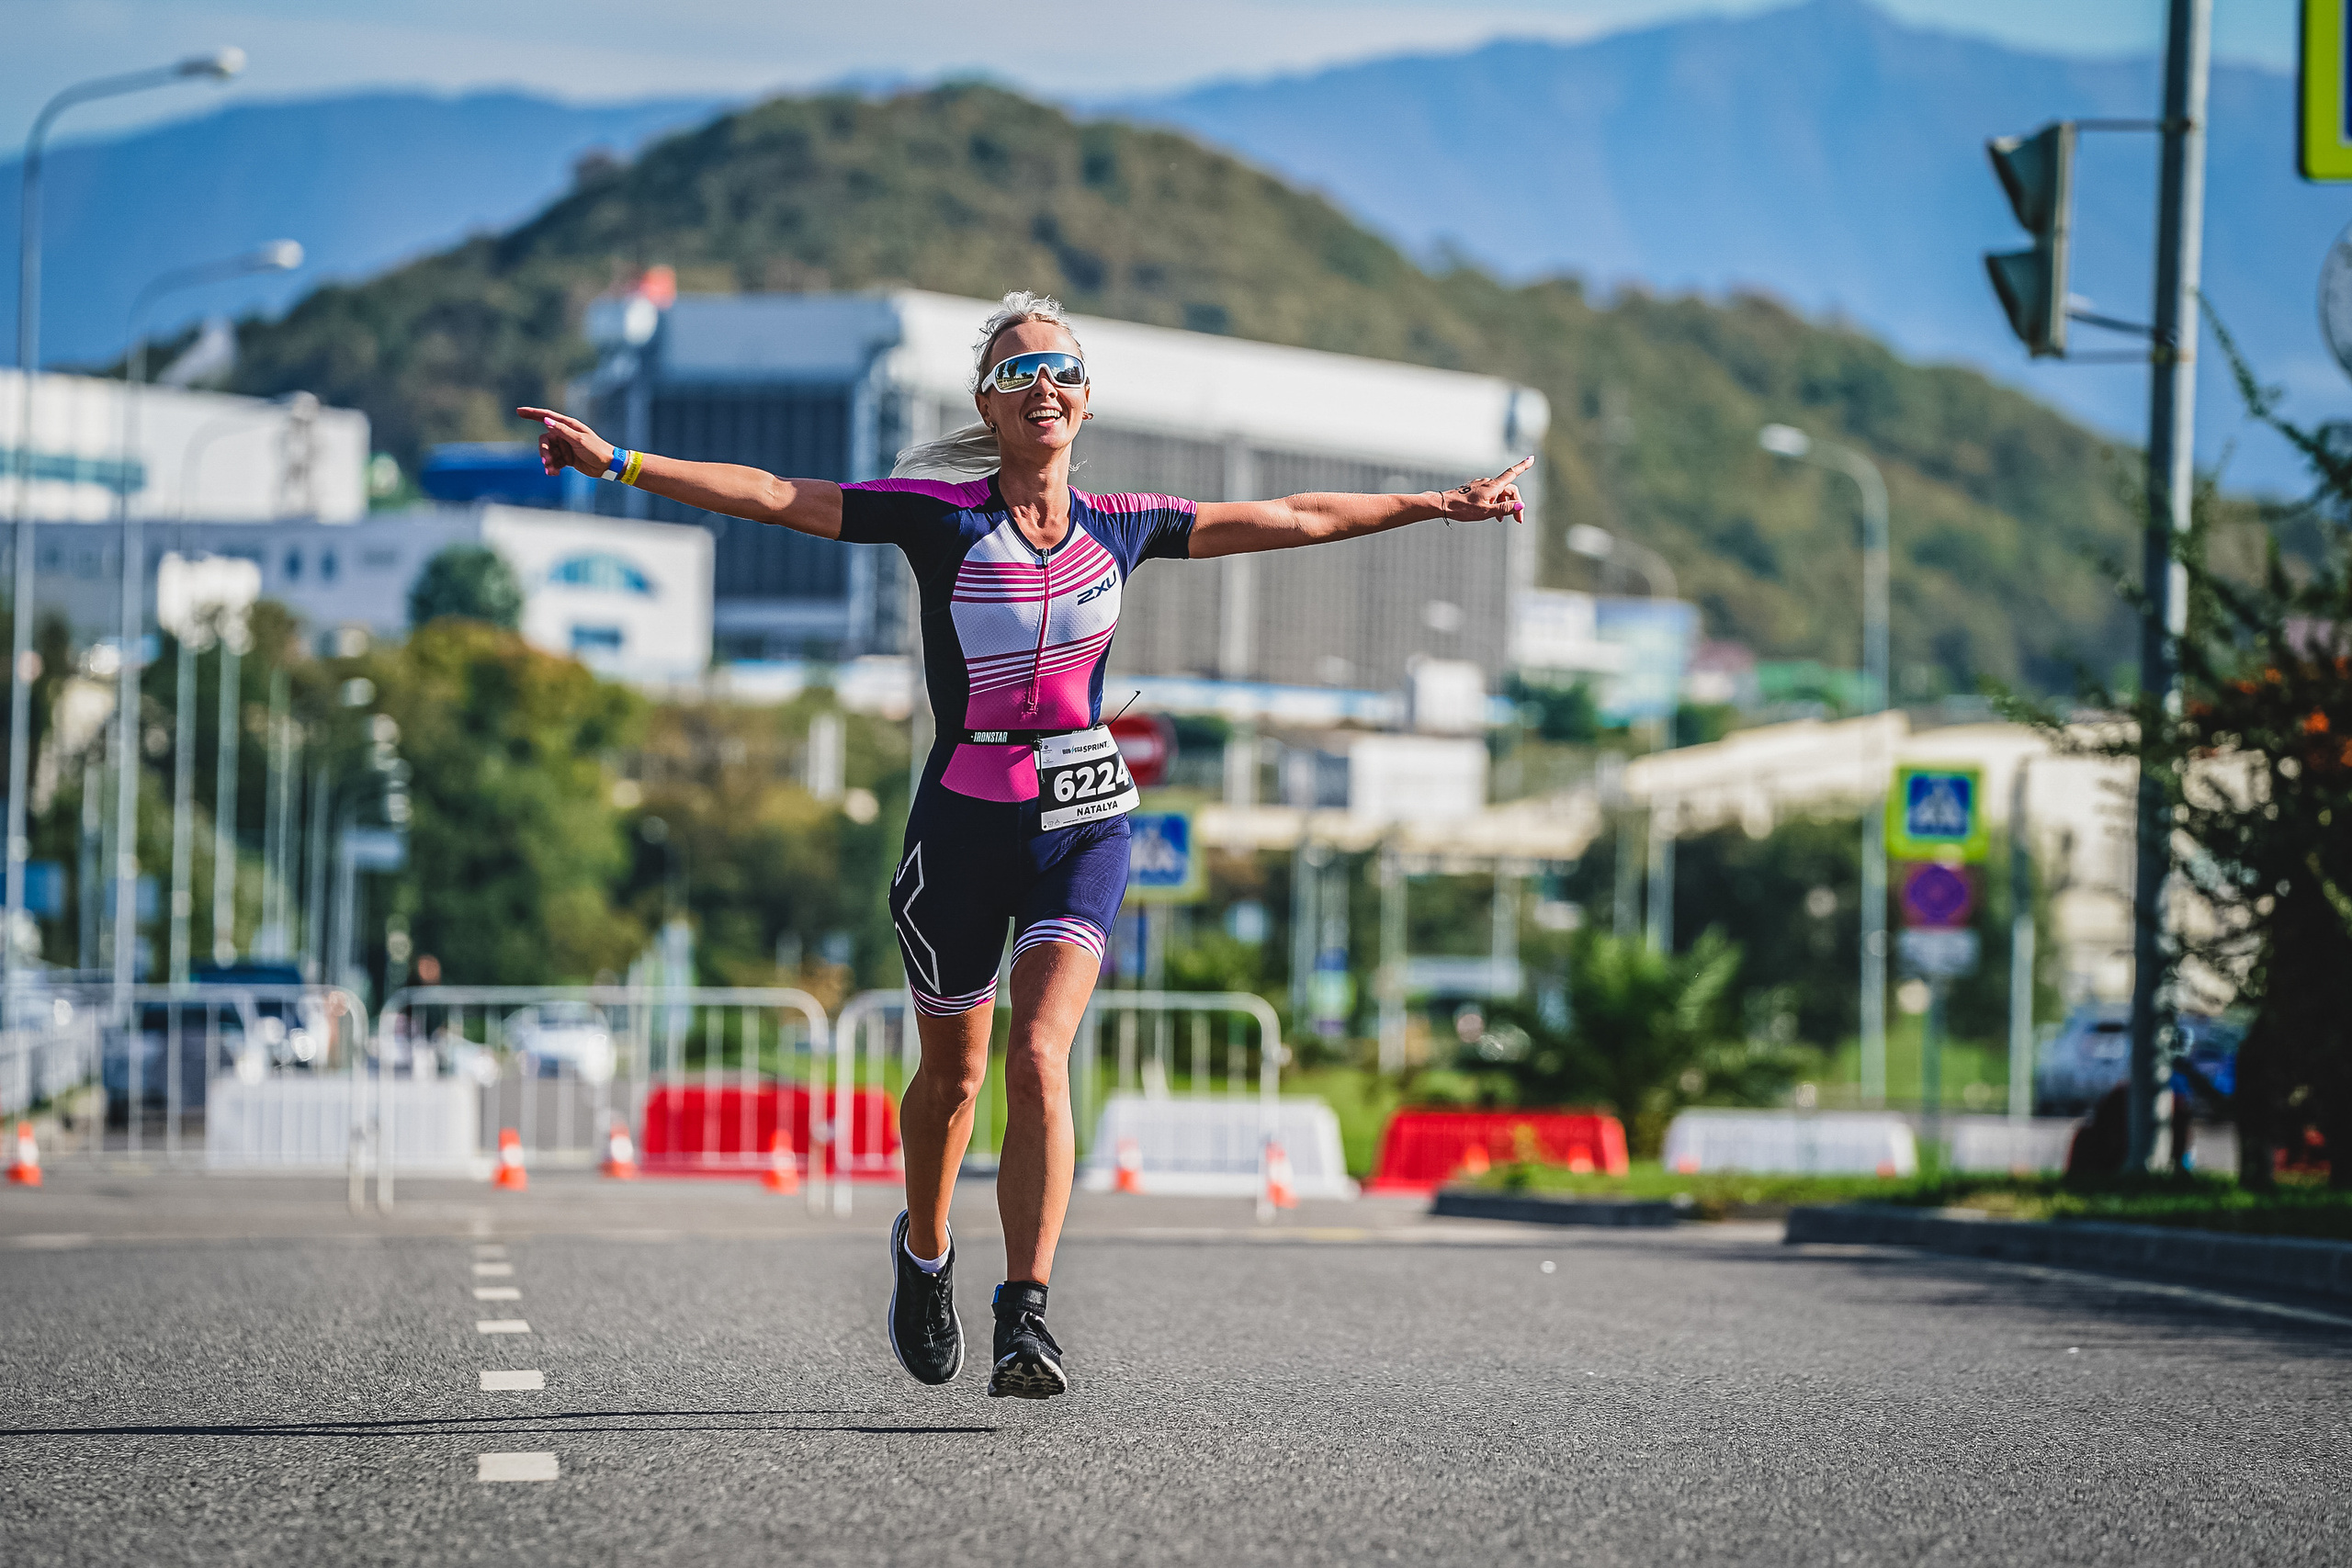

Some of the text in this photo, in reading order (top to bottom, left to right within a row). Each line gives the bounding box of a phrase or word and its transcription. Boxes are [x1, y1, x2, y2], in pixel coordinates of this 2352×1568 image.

[1077, 570, 1117, 606] 2XU
[973, 731, 1008, 743] IRONSTAR
[1082, 740, 1108, 753] SPRINT
[1053, 754, 1130, 803] 6224
[1076, 800, 1118, 817] NATALYA
